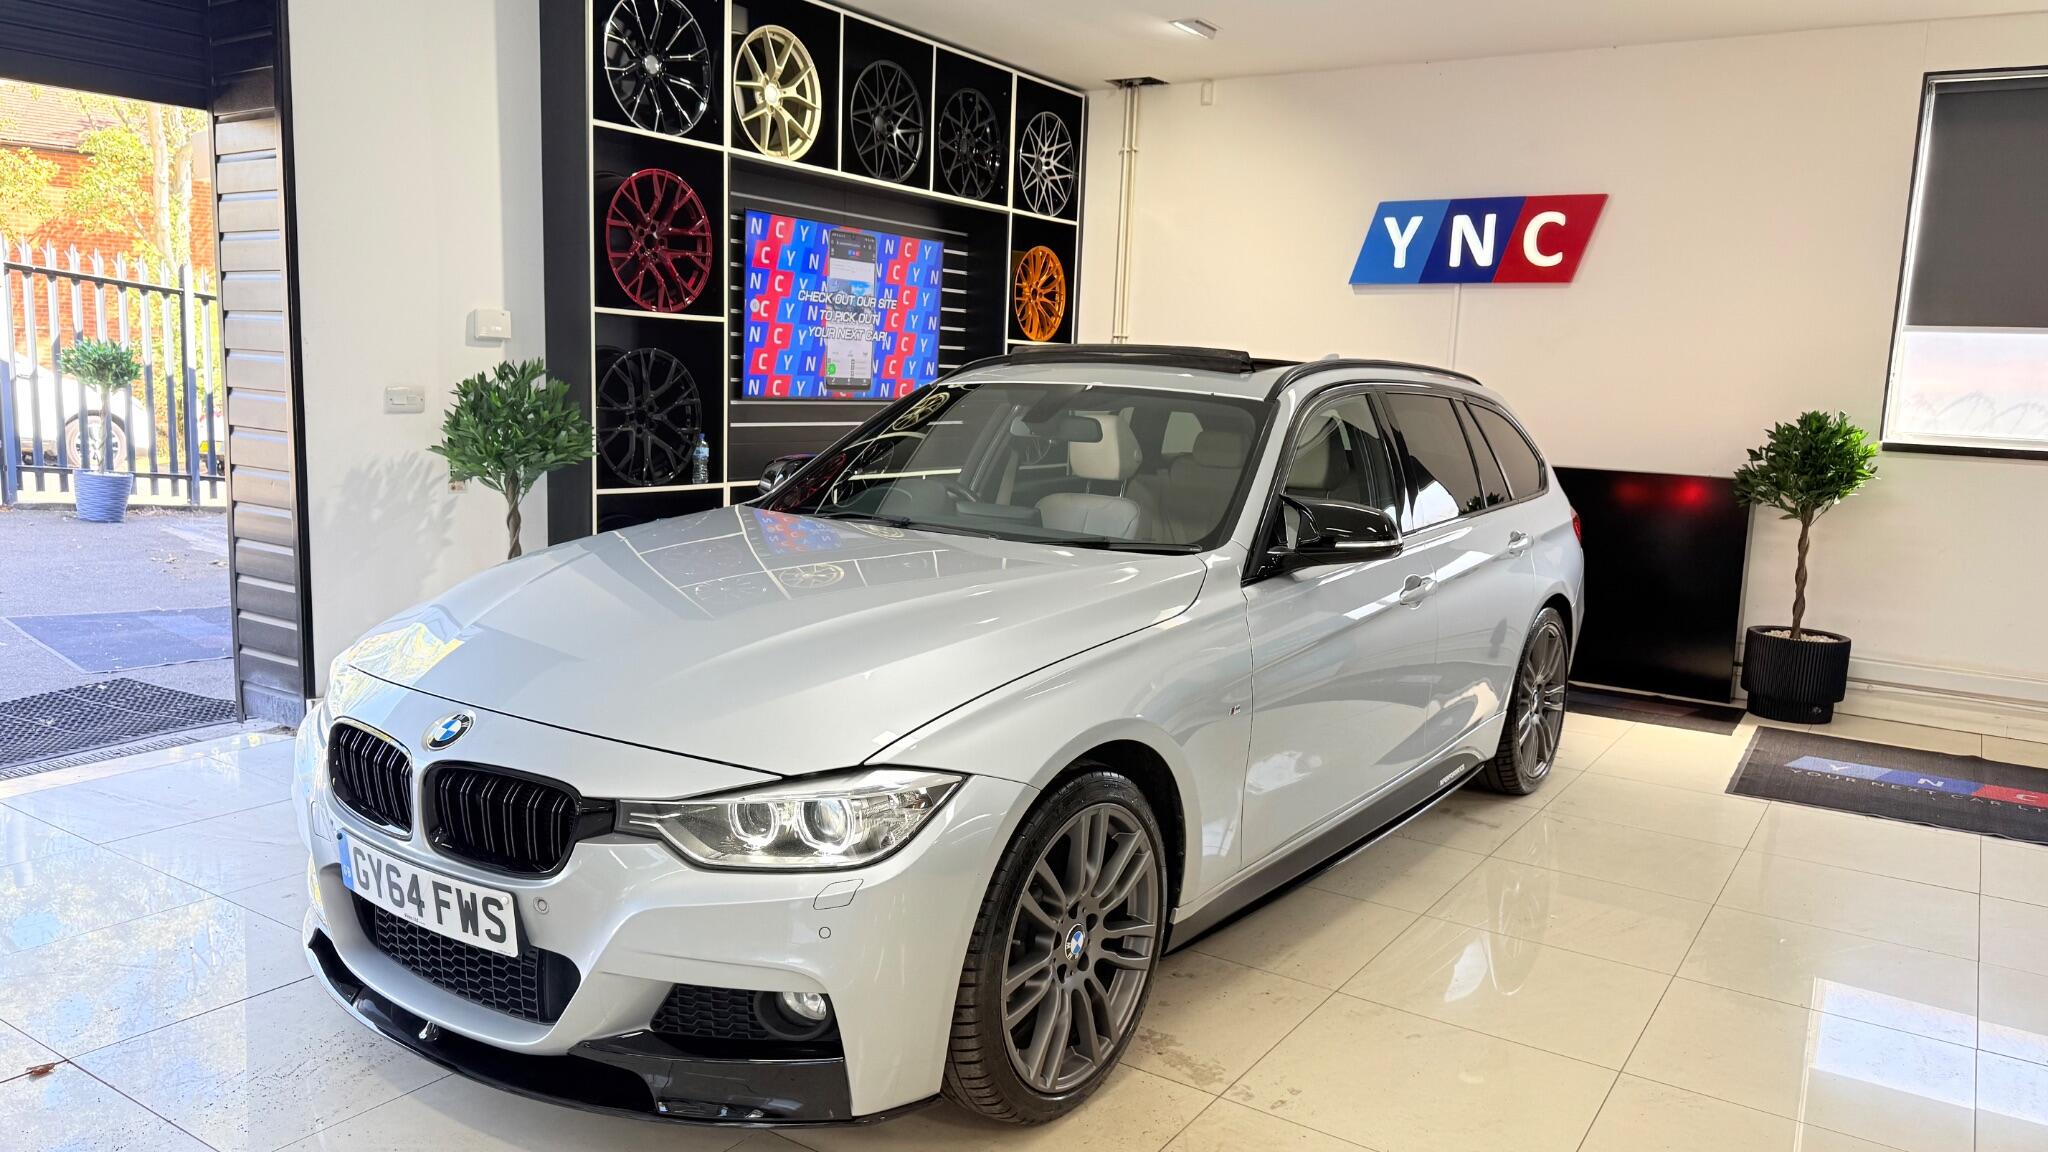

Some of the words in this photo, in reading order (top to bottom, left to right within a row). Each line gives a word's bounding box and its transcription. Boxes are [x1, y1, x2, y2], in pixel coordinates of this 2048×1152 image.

[1384, 211, 1566, 268] YNC
[798, 290, 834, 303] CHECK
[835, 294, 855, 305] OUT
[857, 296, 876, 307] OUR
[878, 298, 897, 309] SITE
[820, 310, 832, 320] TO
[835, 312, 857, 322] PICK
[858, 313, 877, 324] OUT
[809, 326, 837, 338] YOUR
[837, 329, 864, 340] NEXT
[1791, 769, 1856, 782] YOUR
[1872, 781, 1936, 795] NEXT
[1951, 794, 2000, 806] CAR
[352, 846, 425, 918] GY64
[431, 880, 506, 944] FWS
